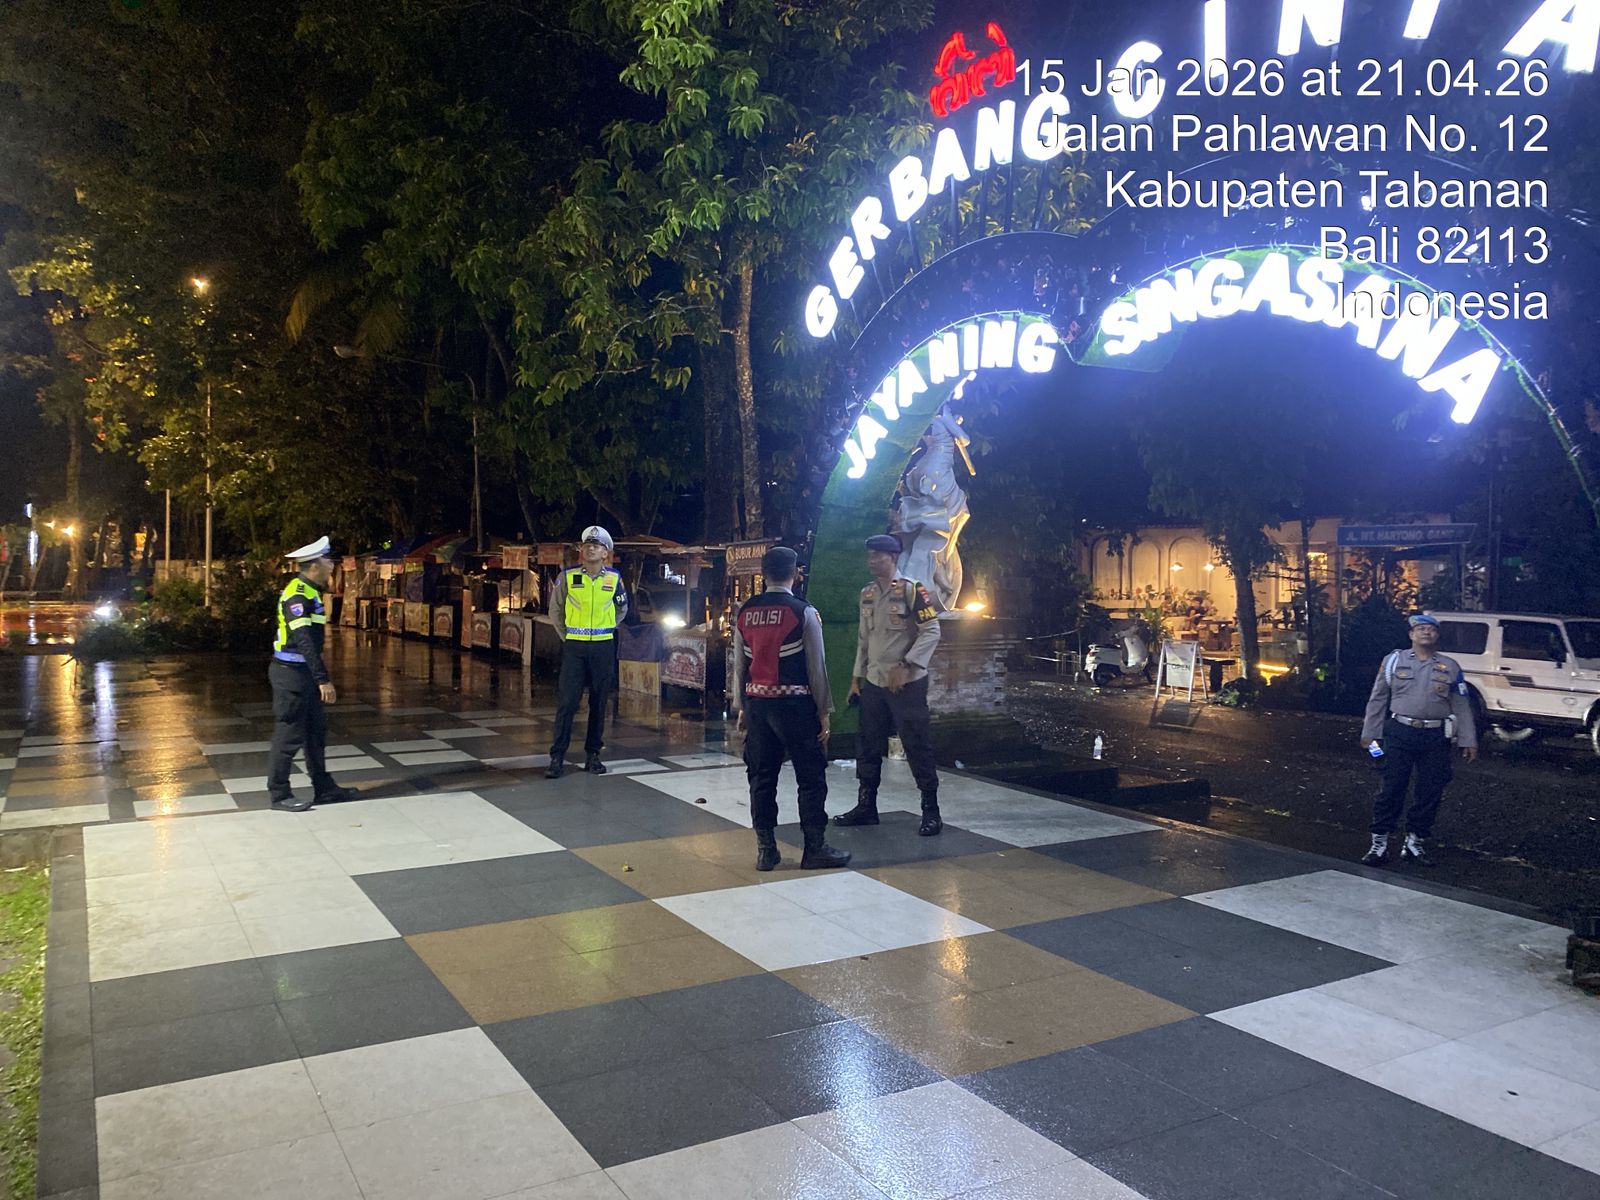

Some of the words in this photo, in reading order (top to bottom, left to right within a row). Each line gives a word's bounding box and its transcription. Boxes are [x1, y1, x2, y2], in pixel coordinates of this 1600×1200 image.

[805, 92, 1071, 338] GERBANG
[843, 320, 1059, 479] JAYANING
[1101, 252, 1502, 425] SINGASANA
[1337, 282, 1549, 320] Indonesia
[745, 610, 782, 626] POLISI
